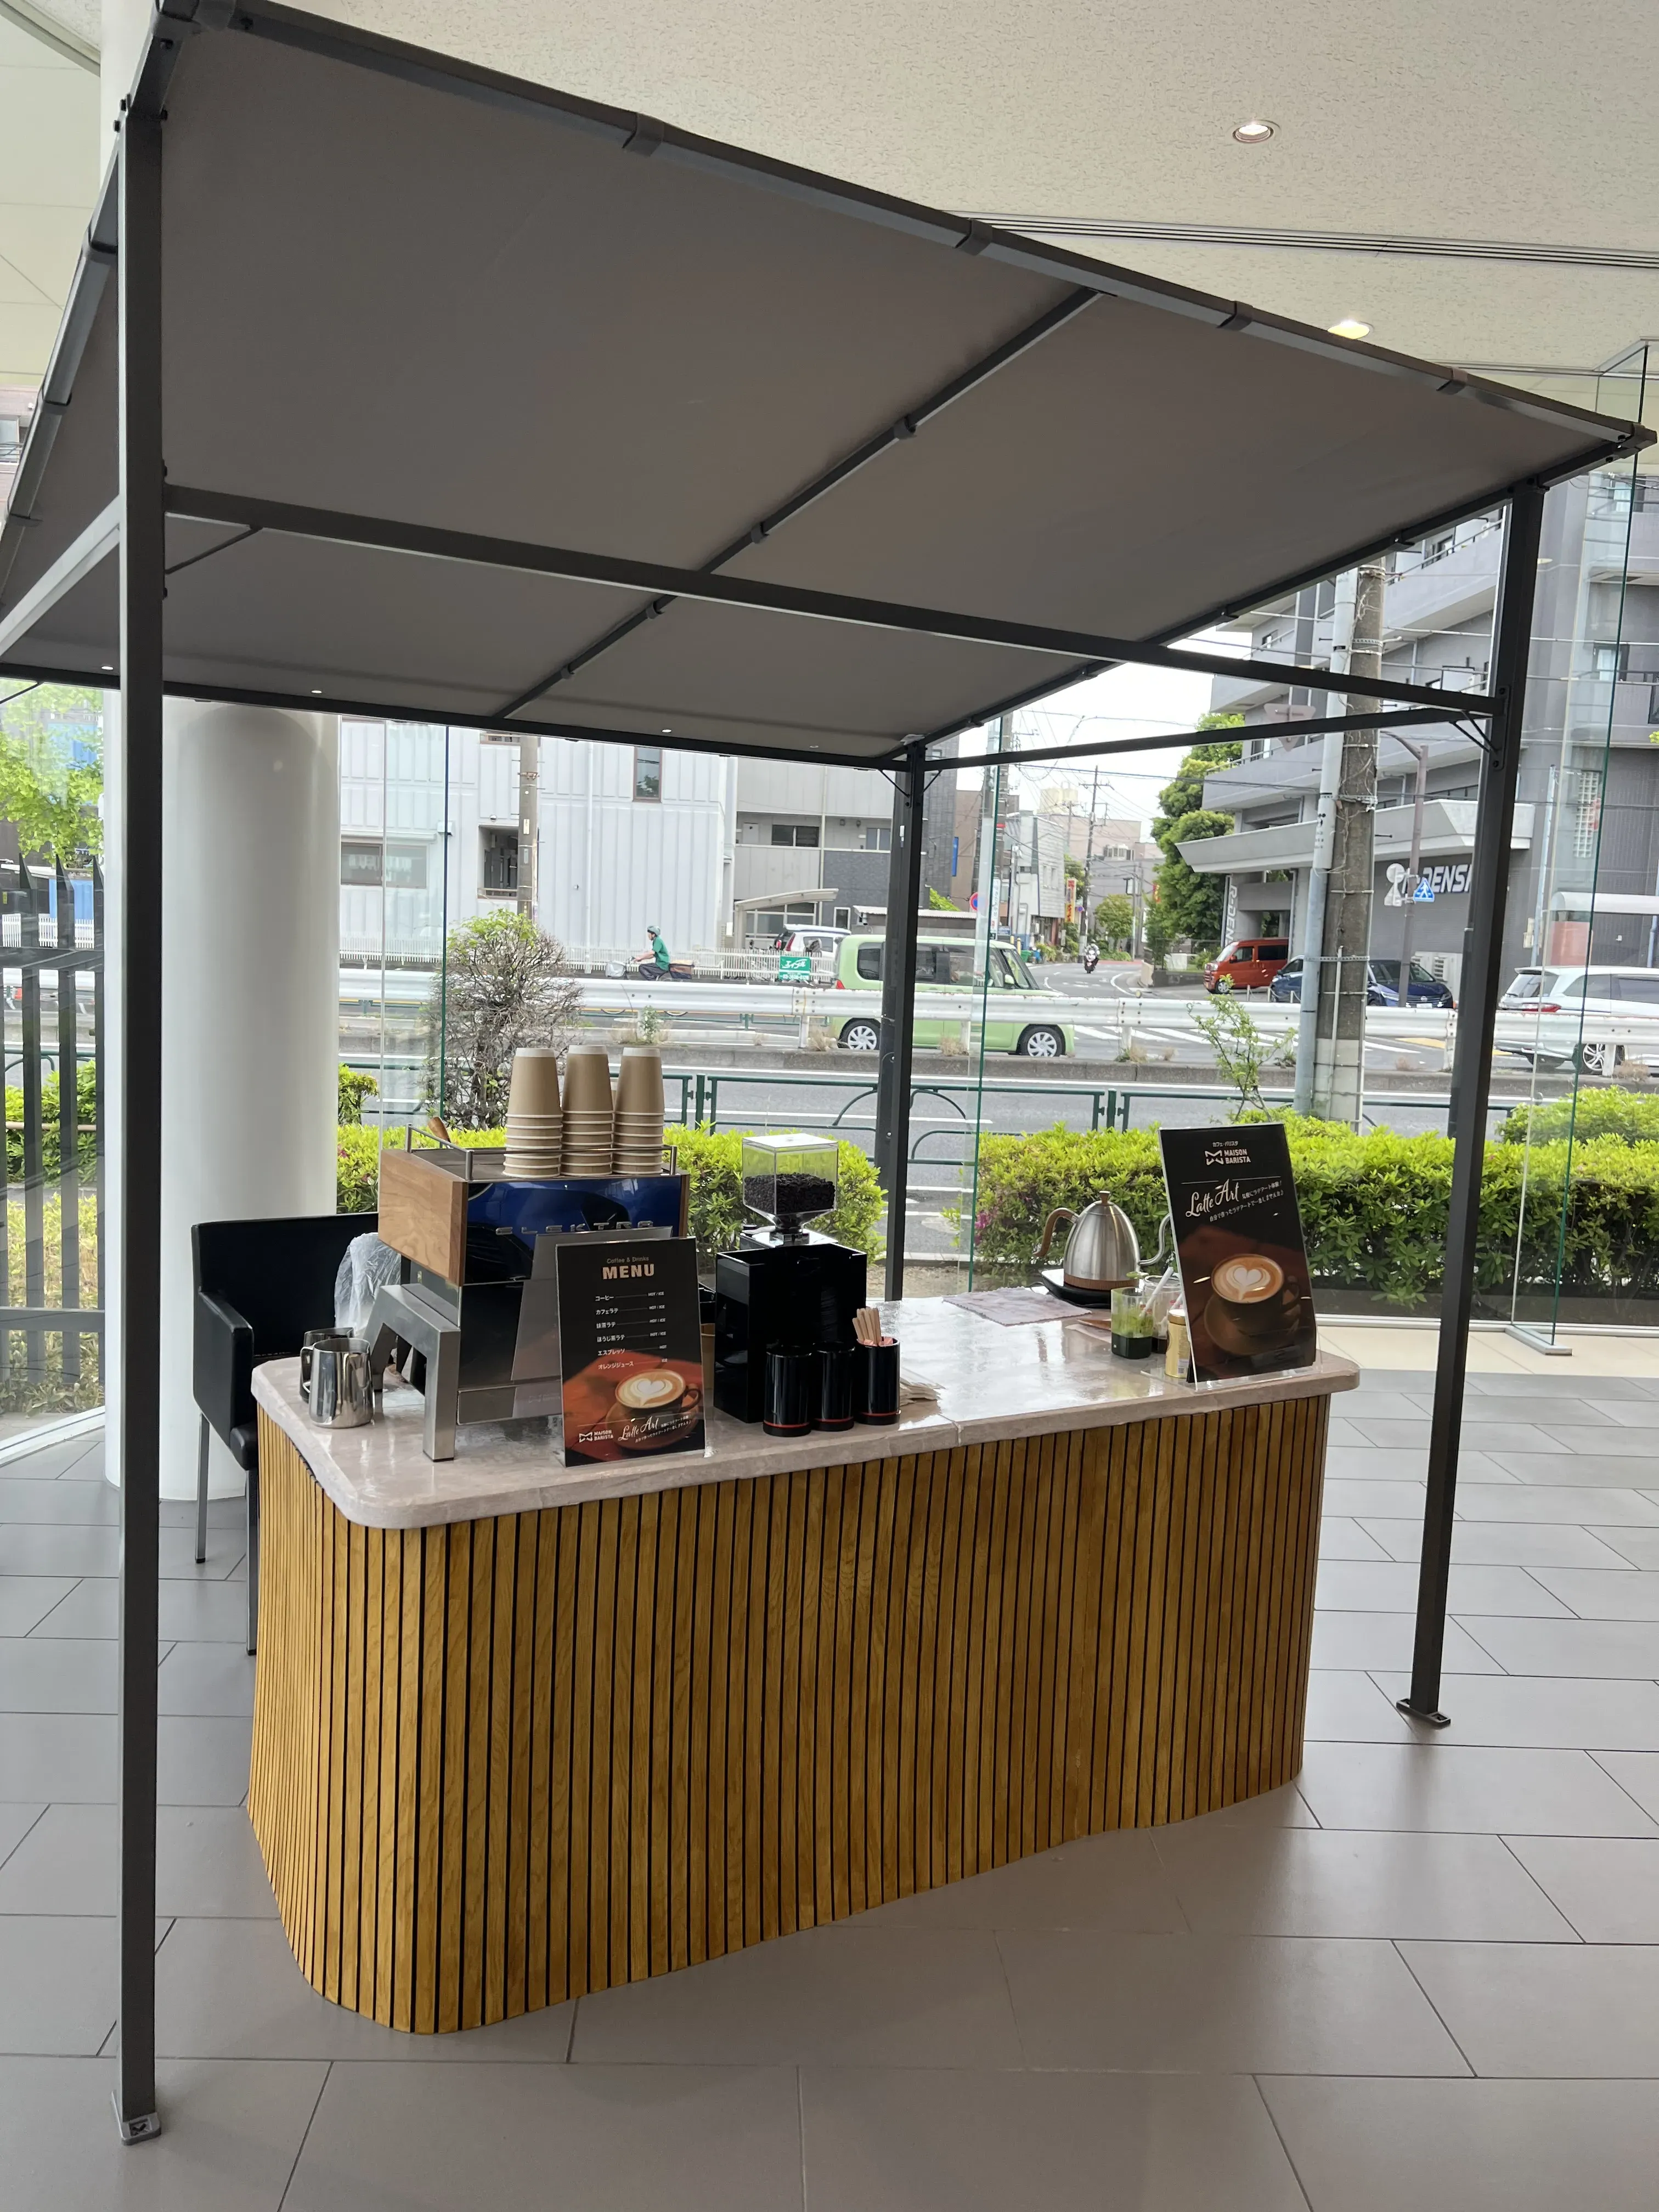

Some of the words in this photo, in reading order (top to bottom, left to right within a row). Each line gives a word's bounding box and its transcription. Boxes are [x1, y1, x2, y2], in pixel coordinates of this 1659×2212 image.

[1225, 1156, 1251, 1164] BARISTA
[1186, 1192, 1214, 1217] Latte
[1215, 1178, 1239, 1205] Art
[602, 1263, 654, 1279] MENU
[598, 1361, 634, 1370] オレンジジュース
